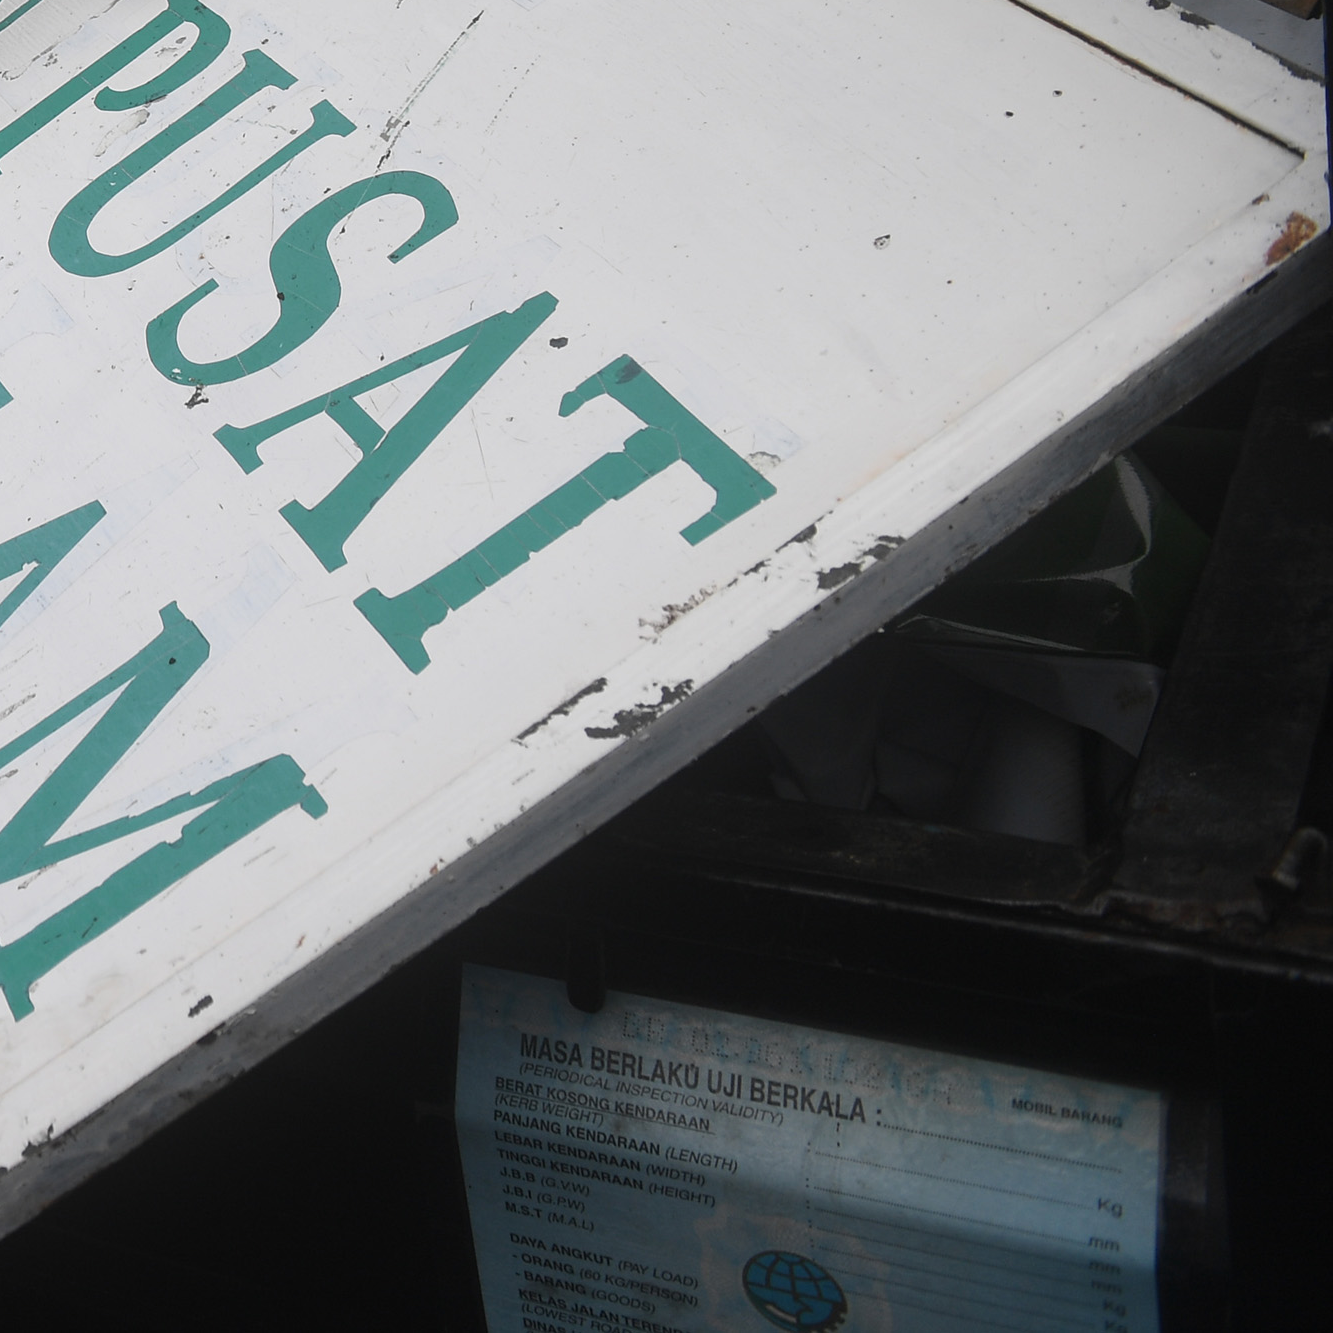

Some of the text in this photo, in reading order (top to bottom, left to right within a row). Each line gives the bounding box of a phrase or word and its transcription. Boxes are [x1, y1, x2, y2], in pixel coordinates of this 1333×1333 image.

[495, 1076, 711, 1132] BERAT KOSONG KENDARAAN
[519, 1062, 785, 1127] (PERIODICAL INSPECTION VALIDITY)
[520, 1033, 583, 1067] MASA
[590, 1047, 700, 1090] BERLAKU
[707, 1070, 744, 1100] UJI
[749, 1078, 867, 1124] BERKALA
[1011, 1097, 1057, 1117] MOBIL
[494, 1092, 605, 1127] (KERB WEIGHT)
[493, 1110, 739, 1175] PANJANG KENDARAAN (LENGTH)
[494, 1130, 706, 1188] LEBAR KENDARAAN (WIDTH)
[497, 1148, 717, 1209] TINGGI KENDARAAN (HEIGHT)
[509, 1232, 700, 1291] DAYA ANGKUT (PAY LOAD)
[521, 1253, 575, 1276] ORANG
[578, 1267, 601, 1283] (60
[518, 1289, 567, 1310] KELAS
[572, 1301, 619, 1323] JALAN
[523, 1269, 656, 1315] BARANG (GOODS)
